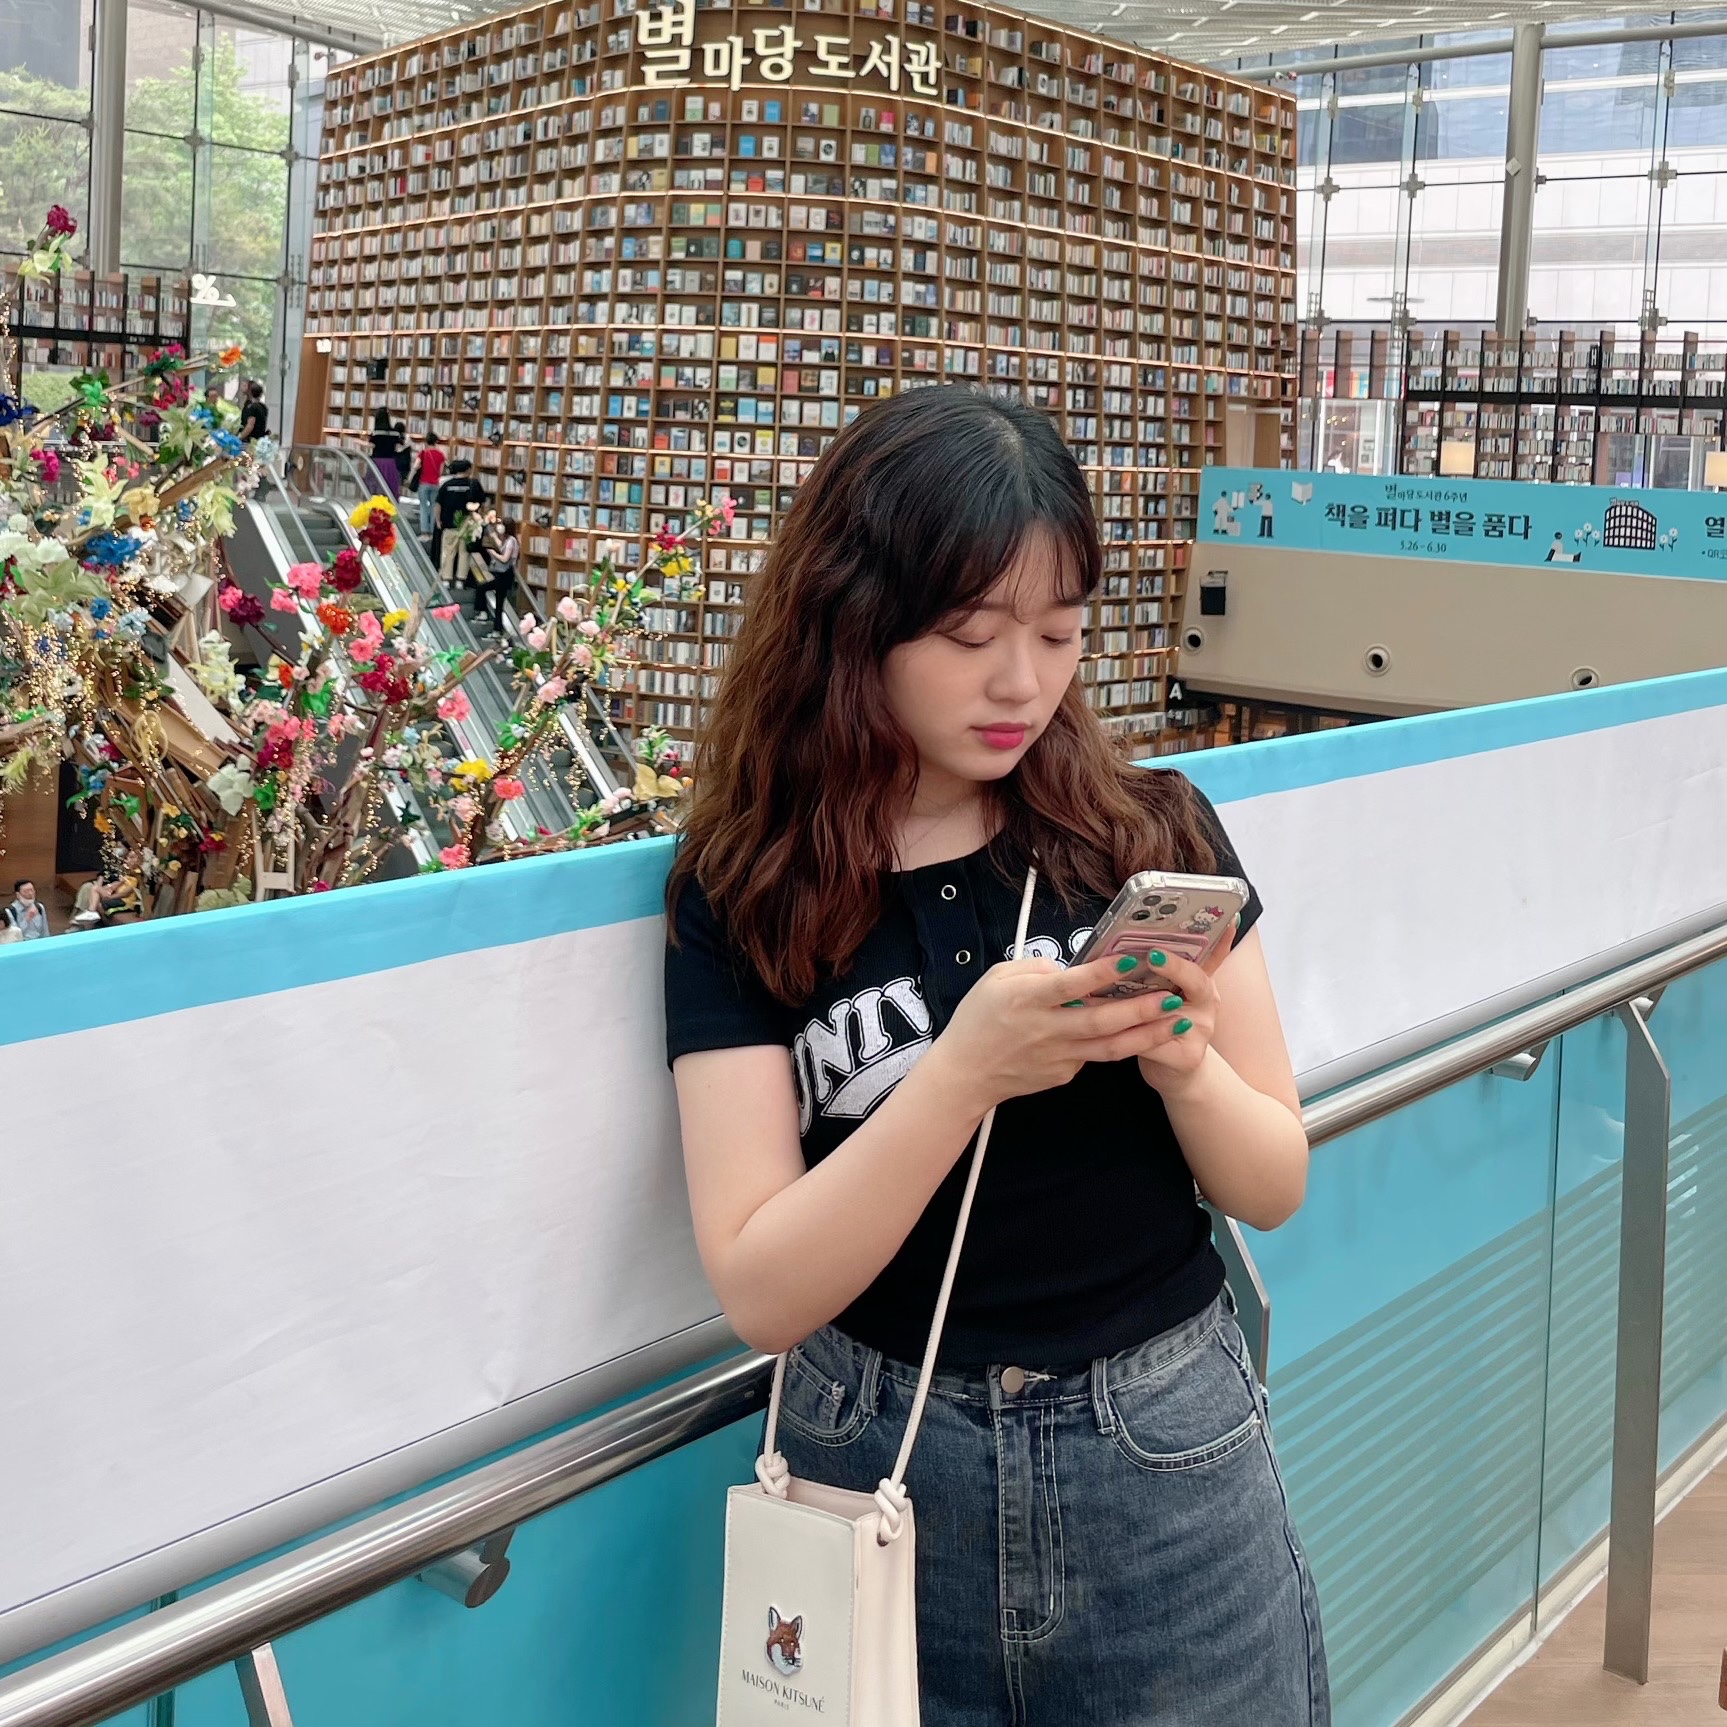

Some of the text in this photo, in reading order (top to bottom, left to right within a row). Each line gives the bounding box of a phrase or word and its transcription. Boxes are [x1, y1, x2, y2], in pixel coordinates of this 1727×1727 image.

[1324, 502, 1533, 540] 책을 펴다 별을 품다
[1169, 682, 1183, 700] A
[742, 1669, 825, 1714] MAISON KITSUNÉ
